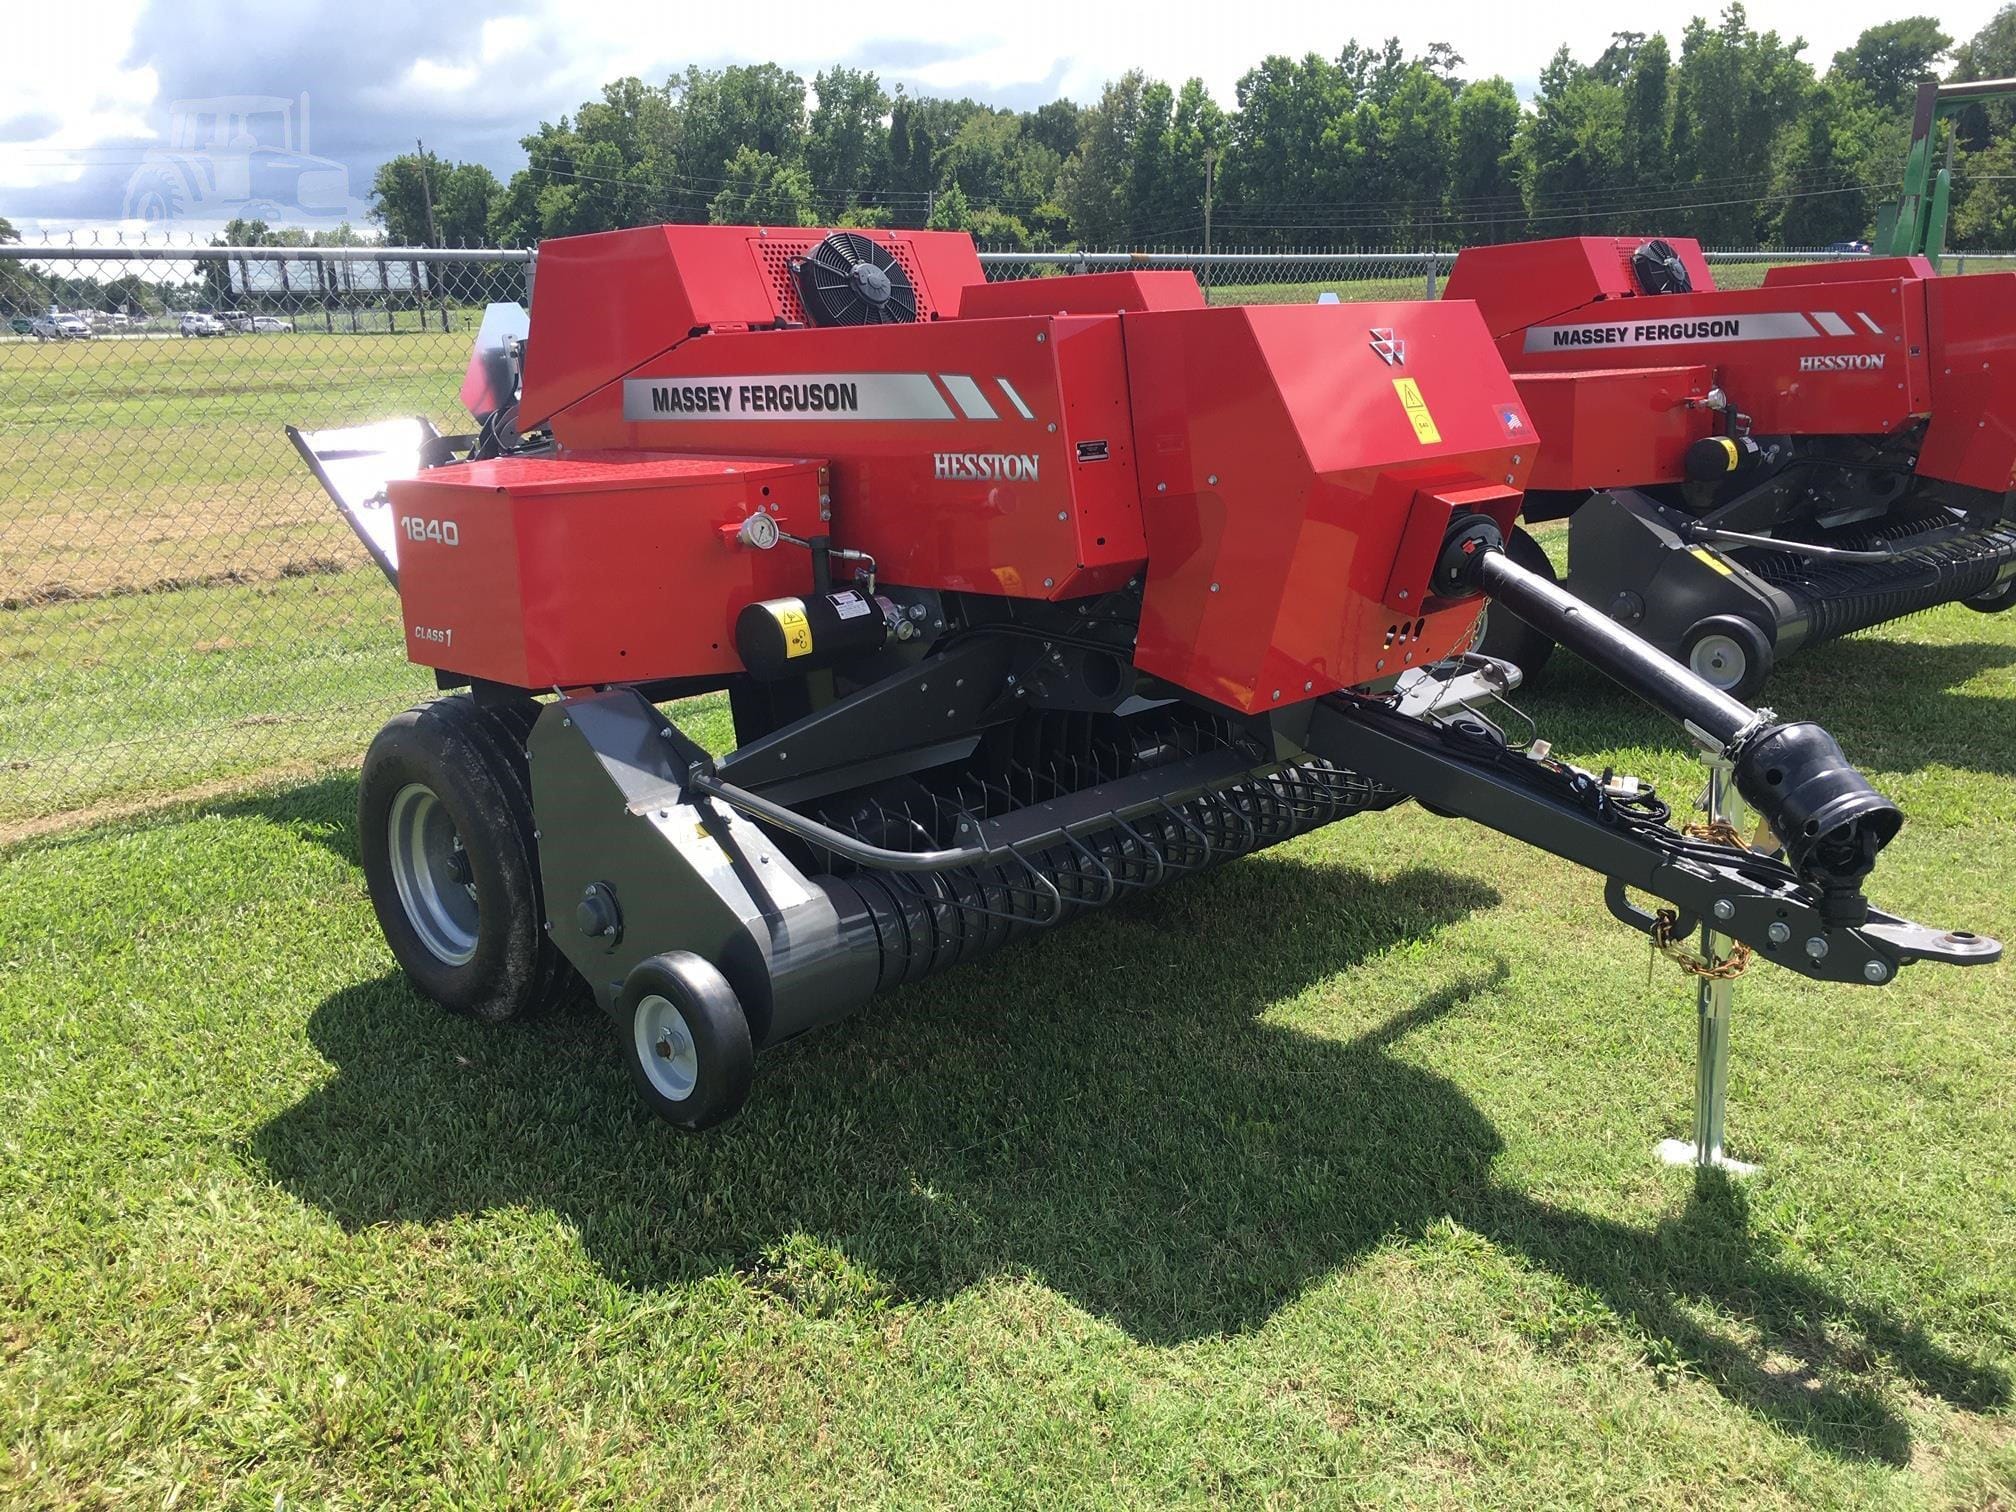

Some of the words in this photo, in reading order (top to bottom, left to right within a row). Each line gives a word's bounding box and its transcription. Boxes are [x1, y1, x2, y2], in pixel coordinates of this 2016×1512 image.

[1553, 327, 1629, 346] MASSEY
[1634, 320, 1739, 341] FERGUSON
[1800, 354, 1885, 371] HESSTON
[652, 386, 732, 412] MASSEY
[739, 383, 858, 411] FERGUSON
[933, 452, 1040, 481] HESSTON
[401, 516, 459, 545] 1840
[415, 626, 444, 643] CLASS
[445, 629, 452, 647] 1
